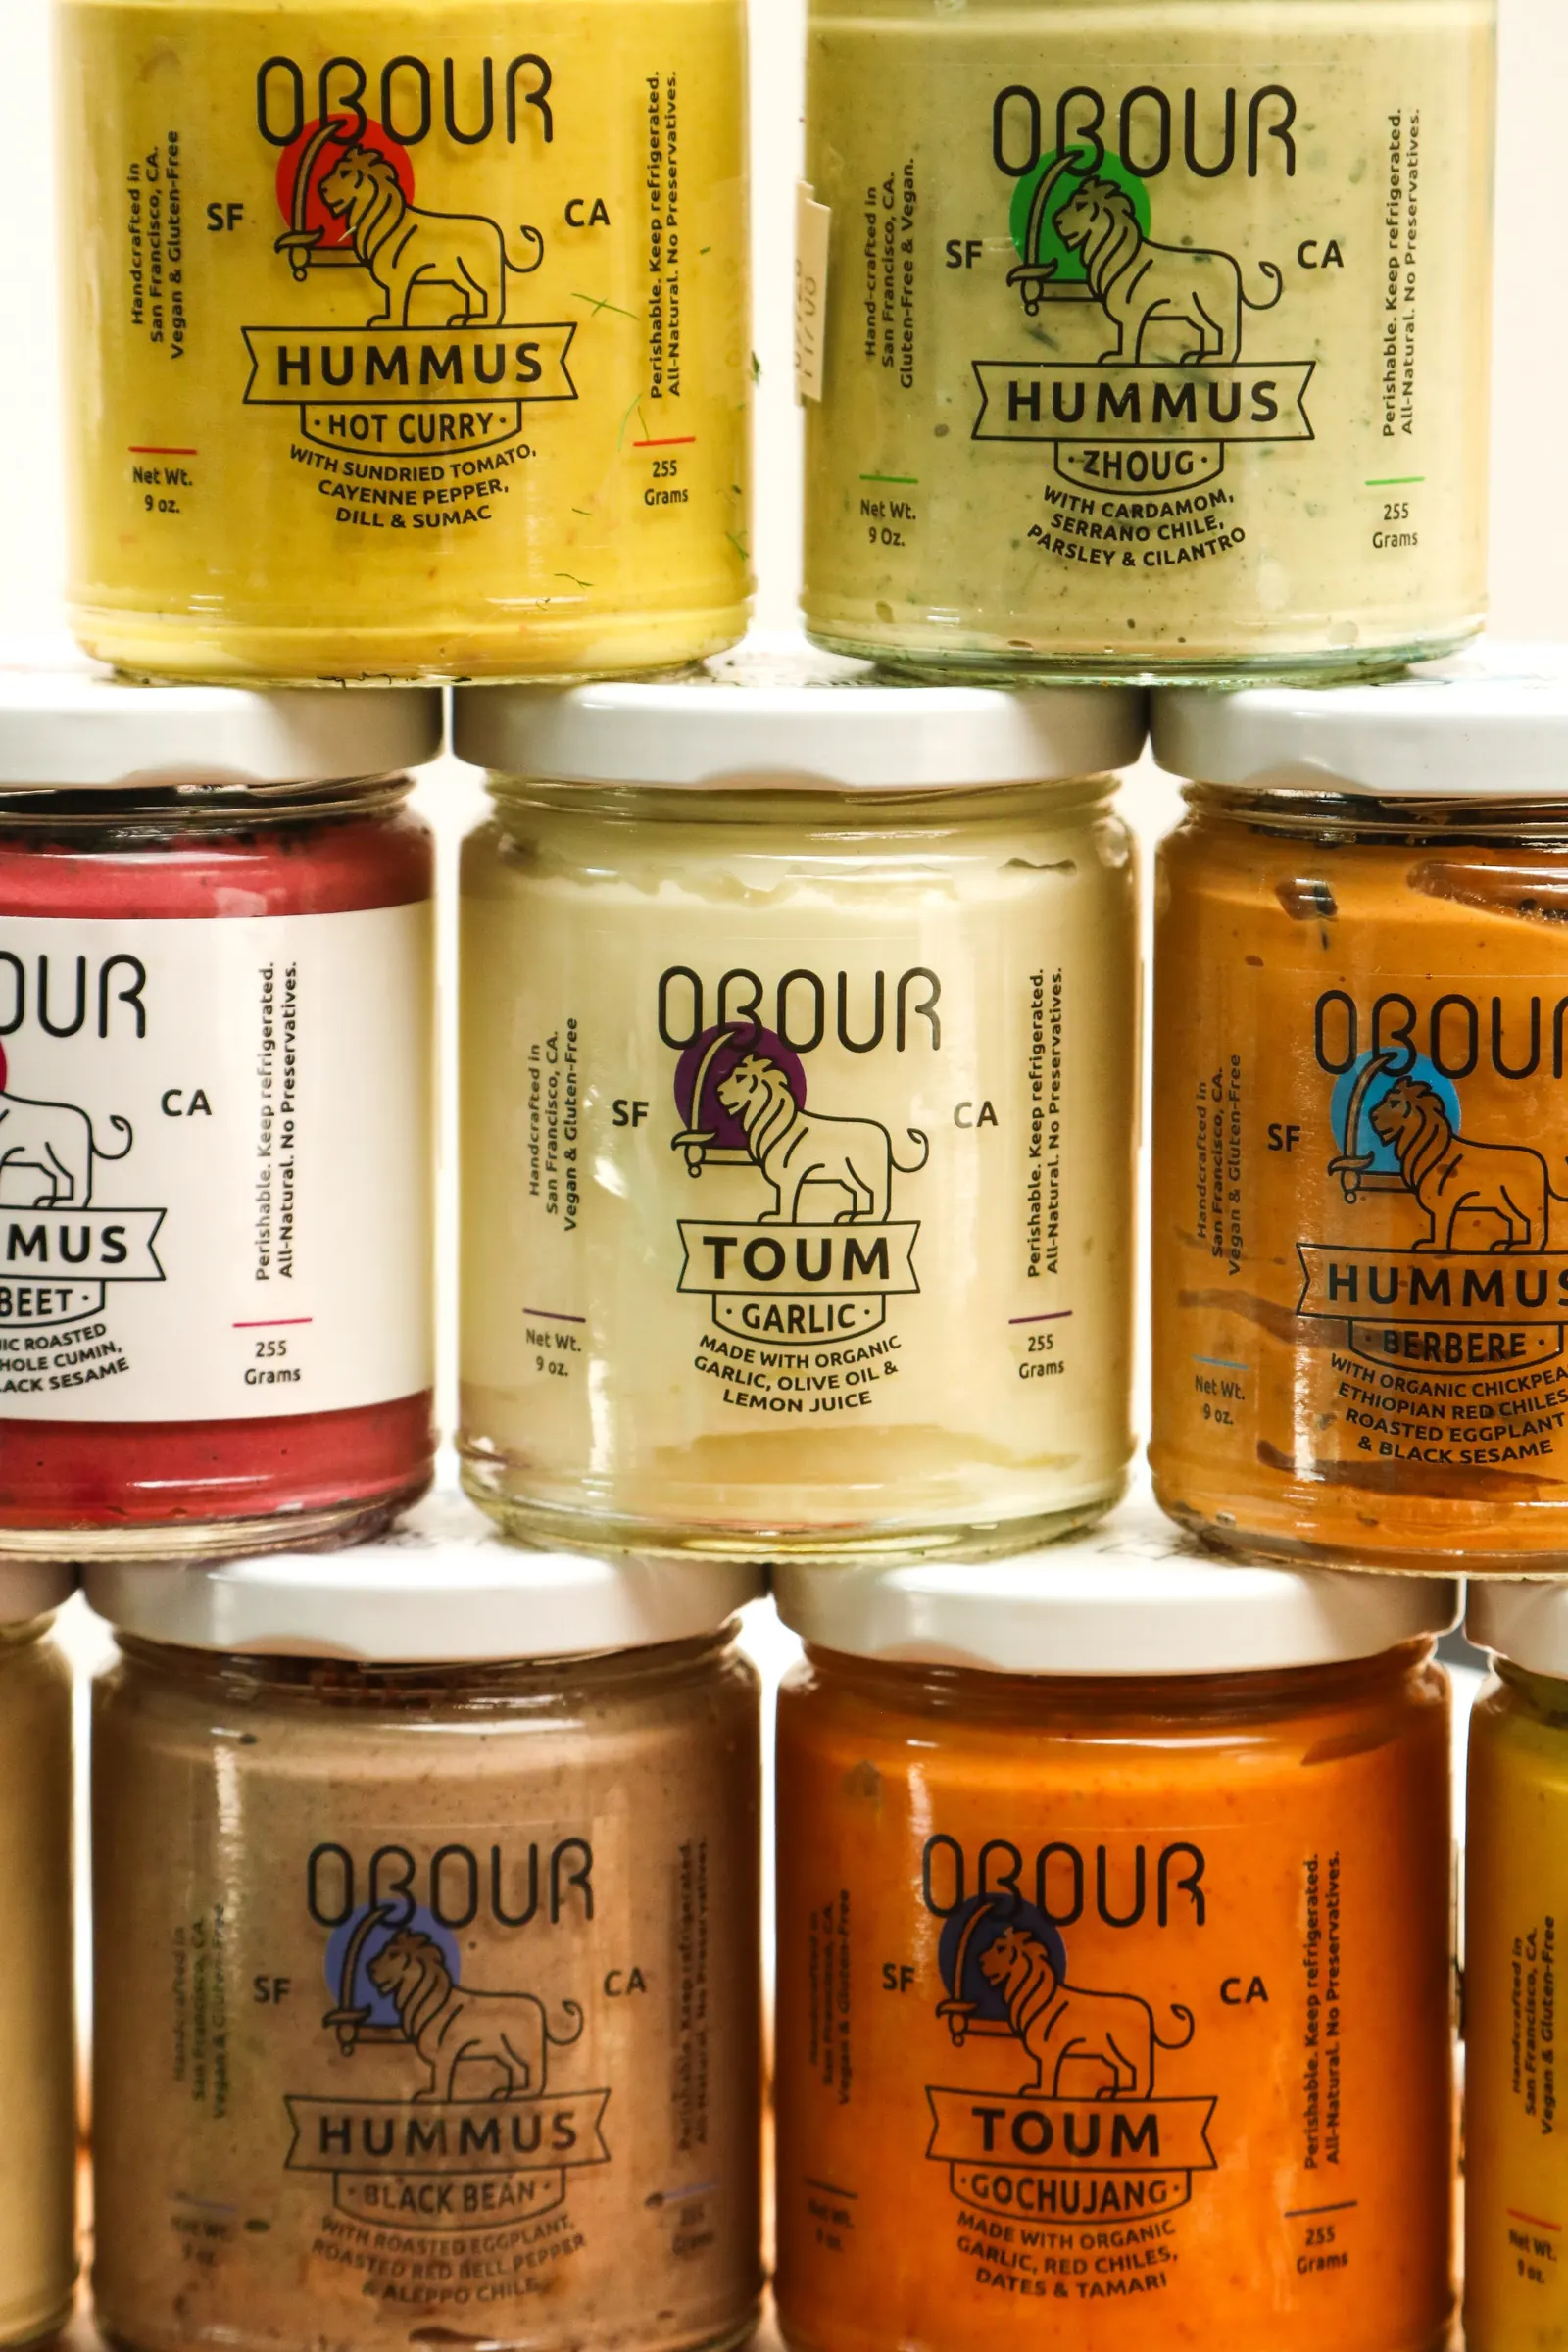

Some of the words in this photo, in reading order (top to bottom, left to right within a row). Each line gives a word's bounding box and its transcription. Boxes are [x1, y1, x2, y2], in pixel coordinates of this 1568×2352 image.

[256, 53, 554, 147] OBOUR
[646, 71, 663, 212] refrigerated.
[664, 71, 678, 222] Preservatives.
[993, 84, 1297, 178] OBOUR
[126, 163, 141, 183] in
[146, 145, 159, 182] CA.
[1385, 108, 1402, 251] refrigerated.
[165, 130, 182, 262] Gluten-Free
[865, 186, 877, 206] in
[883, 172, 895, 211] CA.
[903, 158, 917, 229] Vegan.
[1404, 108, 1420, 266] Preservatives.
[206, 202, 244, 231] SF
[564, 198, 611, 227] CA
[127, 187, 144, 325] Handcrafted
[146, 189, 163, 297] Francisco,
[649, 219, 663, 272] Keep
[667, 233, 678, 264] No
[902, 238, 914, 252] &
[945, 239, 983, 270] SF
[1297, 239, 1345, 270] CA
[169, 273, 182, 284] &
[864, 212, 877, 358] Hand-crafted
[881, 216, 896, 324] Francisco,
[1384, 255, 1399, 311] Keep
[1403, 270, 1416, 301] No
[150, 307, 164, 343] San
[171, 290, 187, 360] Vegan
[648, 278, 662, 399] Perishable.
[666, 270, 680, 397] All-Natural.
[900, 258, 914, 389] Gluten-Free
[277, 342, 543, 386] HUMMUS
[882, 330, 894, 368] San
[1382, 317, 1396, 437] Perishable.
[1400, 309, 1415, 435] All-Natural.
[1007, 380, 1279, 424] HUMMUS
[328, 414, 388, 443] HOT
[398, 412, 494, 444] CURRY
[132, 466, 159, 486] Net
[164, 466, 194, 487] Wt.
[290, 443, 339, 473] WITH
[342, 460, 446, 482] SUNDRIED
[449, 443, 537, 478] TOMATO,
[651, 459, 678, 479] 255
[1082, 449, 1195, 482] ZHOUG
[144, 493, 154, 513] 9
[159, 497, 181, 514] oz.
[318, 479, 417, 506] CAYENNE
[423, 478, 510, 505] PEPPER,
[643, 485, 689, 507] Grams
[859, 498, 886, 518] Net
[889, 500, 917, 520] Wt.
[1044, 485, 1095, 515] WITH
[1101, 488, 1235, 519] CARDAMOM,
[335, 507, 385, 528] DILL
[390, 513, 406, 528] &
[413, 505, 492, 528] SUMAC
[1050, 513, 1151, 542] SERRANO
[1157, 514, 1225, 541] CHILE,
[1383, 501, 1409, 521] 255
[868, 526, 877, 544] 9
[881, 527, 906, 547] Oz.
[1027, 523, 1116, 567] PARSLEY
[1122, 551, 1136, 567] &
[1143, 526, 1246, 567] CILANTRO
[1372, 531, 1418, 549] Grams
[658, 965, 942, 1054] OBOUR
[256, 961, 275, 1101] refrigerated.
[279, 961, 298, 1115] Preservatives.
[1027, 968, 1046, 1102] refrigerated.
[1048, 967, 1063, 1115] Preservatives.
[160, 1088, 213, 1118] CA
[612, 1099, 650, 1128] SF
[953, 1099, 999, 1129] CA
[256, 1104, 275, 1157] Keep
[280, 1118, 296, 1149] No
[1029, 1106, 1046, 1158] Keep
[1049, 1121, 1061, 1150] No
[1267, 1122, 1300, 1152] SF
[255, 1163, 272, 1281] Perishable.
[278, 1154, 296, 1279] All-Natural.
[1027, 1164, 1042, 1278] Perishable.
[1047, 1154, 1061, 1275] All-Natural.
[702, 1235, 890, 1282] TOUM
[741, 1302, 856, 1334] GARLIC
[24, 1323, 107, 1351] ROASTED
[53, 1340, 122, 1368] CUMIN,
[255, 1340, 287, 1358] 255
[525, 1328, 551, 1348] Net
[554, 1332, 582, 1353] Wt.
[699, 1334, 756, 1364] MADE
[760, 1351, 809, 1369] WITH
[814, 1334, 902, 1368] ORGANIC
[1027, 1334, 1054, 1352] 255
[1383, 1329, 1527, 1364] BERBERE
[50, 1357, 130, 1390] SESAME
[244, 1367, 301, 1386] Grams
[536, 1355, 545, 1372] 9
[548, 1361, 568, 1377] oz.
[694, 1355, 772, 1392] GARLIC,
[777, 1374, 841, 1392] OLIVE
[845, 1367, 880, 1387] OIL
[883, 1360, 899, 1376] &
[1018, 1359, 1065, 1380] Grams
[1331, 1352, 1375, 1384] WITH
[1379, 1373, 1467, 1397] ORGANIC
[1471, 1366, 1568, 1397] CHICKPEA
[722, 1388, 803, 1412] LEMON
[808, 1390, 872, 1412] JUICE
[1195, 1373, 1217, 1396] Net
[1218, 1380, 1246, 1401] Wt.
[1338, 1382, 1446, 1420] ETHIOPIAN
[1451, 1403, 1494, 1420] RED
[1201, 1404, 1211, 1421] 9
[1212, 1409, 1234, 1426] oz.
[1346, 1407, 1444, 1442] ROASTED
[1449, 1411, 1566, 1443] EGGPLANT
[1357, 1435, 1373, 1452] &
[1379, 1442, 1454, 1465] BLACK
[1459, 1439, 1554, 1465] SESAME
[306, 1837, 595, 1930] OBOUR
[922, 1834, 1206, 1929] OBOUR
[253, 1974, 291, 2005] SF
[603, 1967, 647, 1998] CA
[882, 1962, 915, 1993] SF
[1219, 1976, 1269, 2005] CA
[318, 2110, 578, 2156] HUMMUS
[971, 2106, 1161, 2158] TOUM
[364, 2183, 453, 2214] BLACK
[463, 2180, 536, 2213] BEAN
[971, 2172, 1167, 2215] GOCHUJANG
[956, 2210, 1016, 2245] MADE
[1020, 2227, 1075, 2250] WITH
[1080, 2219, 1175, 2251] ORGANIC
[1304, 2225, 1336, 2246] 255
[956, 2235, 1039, 2275] GARLIC,
[1044, 2255, 1088, 2277] RED
[1095, 2246, 1178, 2275] CHILES,
[1296, 2252, 1349, 2276] Grams
[975, 2267, 1048, 2297] DATES
[1053, 2279, 1069, 2298] &
[1076, 2272, 1167, 2299] TAMARI
